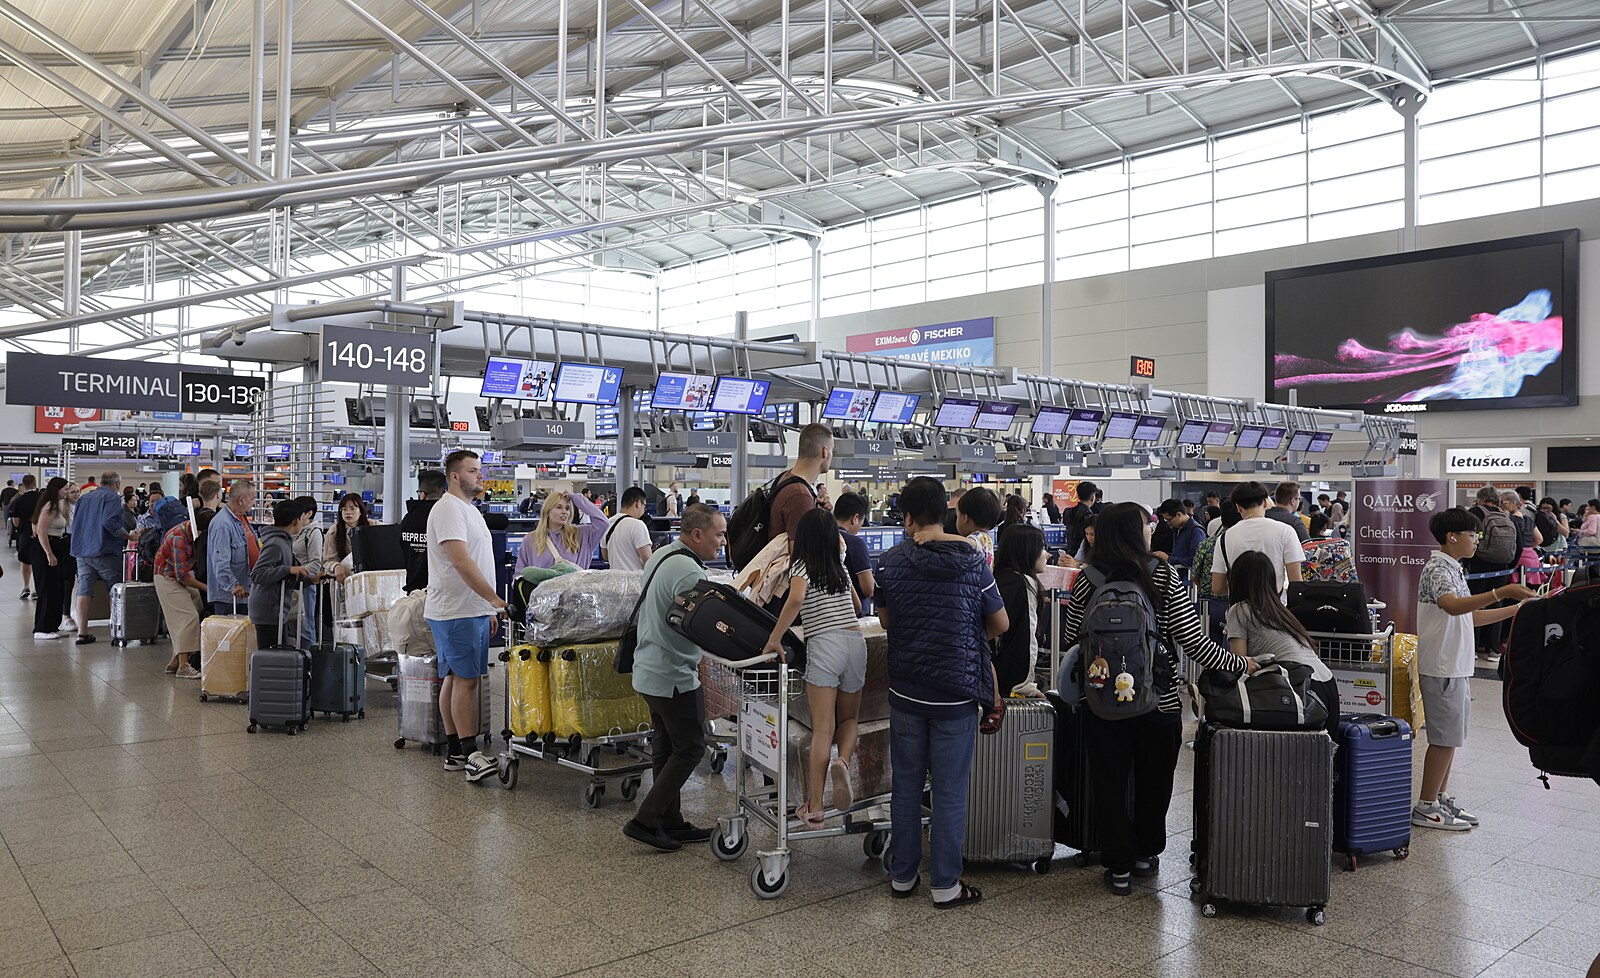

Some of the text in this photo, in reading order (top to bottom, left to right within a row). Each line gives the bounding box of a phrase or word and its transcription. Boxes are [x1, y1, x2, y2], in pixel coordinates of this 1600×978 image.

[924, 326, 963, 340] FISCHER
[328, 340, 426, 373] 140-148
[931, 347, 971, 361] MEXIKO
[1136, 359, 1153, 376] 13:09
[58, 371, 177, 397] TERMINAL
[185, 383, 262, 405] 130-138
[1384, 404, 1427, 412] JCDecaux
[546, 424, 563, 435] 140
[98, 436, 136, 447] 121-128
[706, 435, 719, 445] 141
[868, 443, 880, 452] 142
[973, 448, 984, 457] 143
[713, 457, 732, 465] 121-128
[1451, 454, 1524, 467] letuška.cz
[1363, 494, 1414, 509] QATAR
[1360, 525, 1413, 539] Check-in
[1360, 554, 1425, 566] Economy Class
[1034, 764, 1045, 813] NATIONAL
[1023, 764, 1034, 828] GEOGRAPHIC
